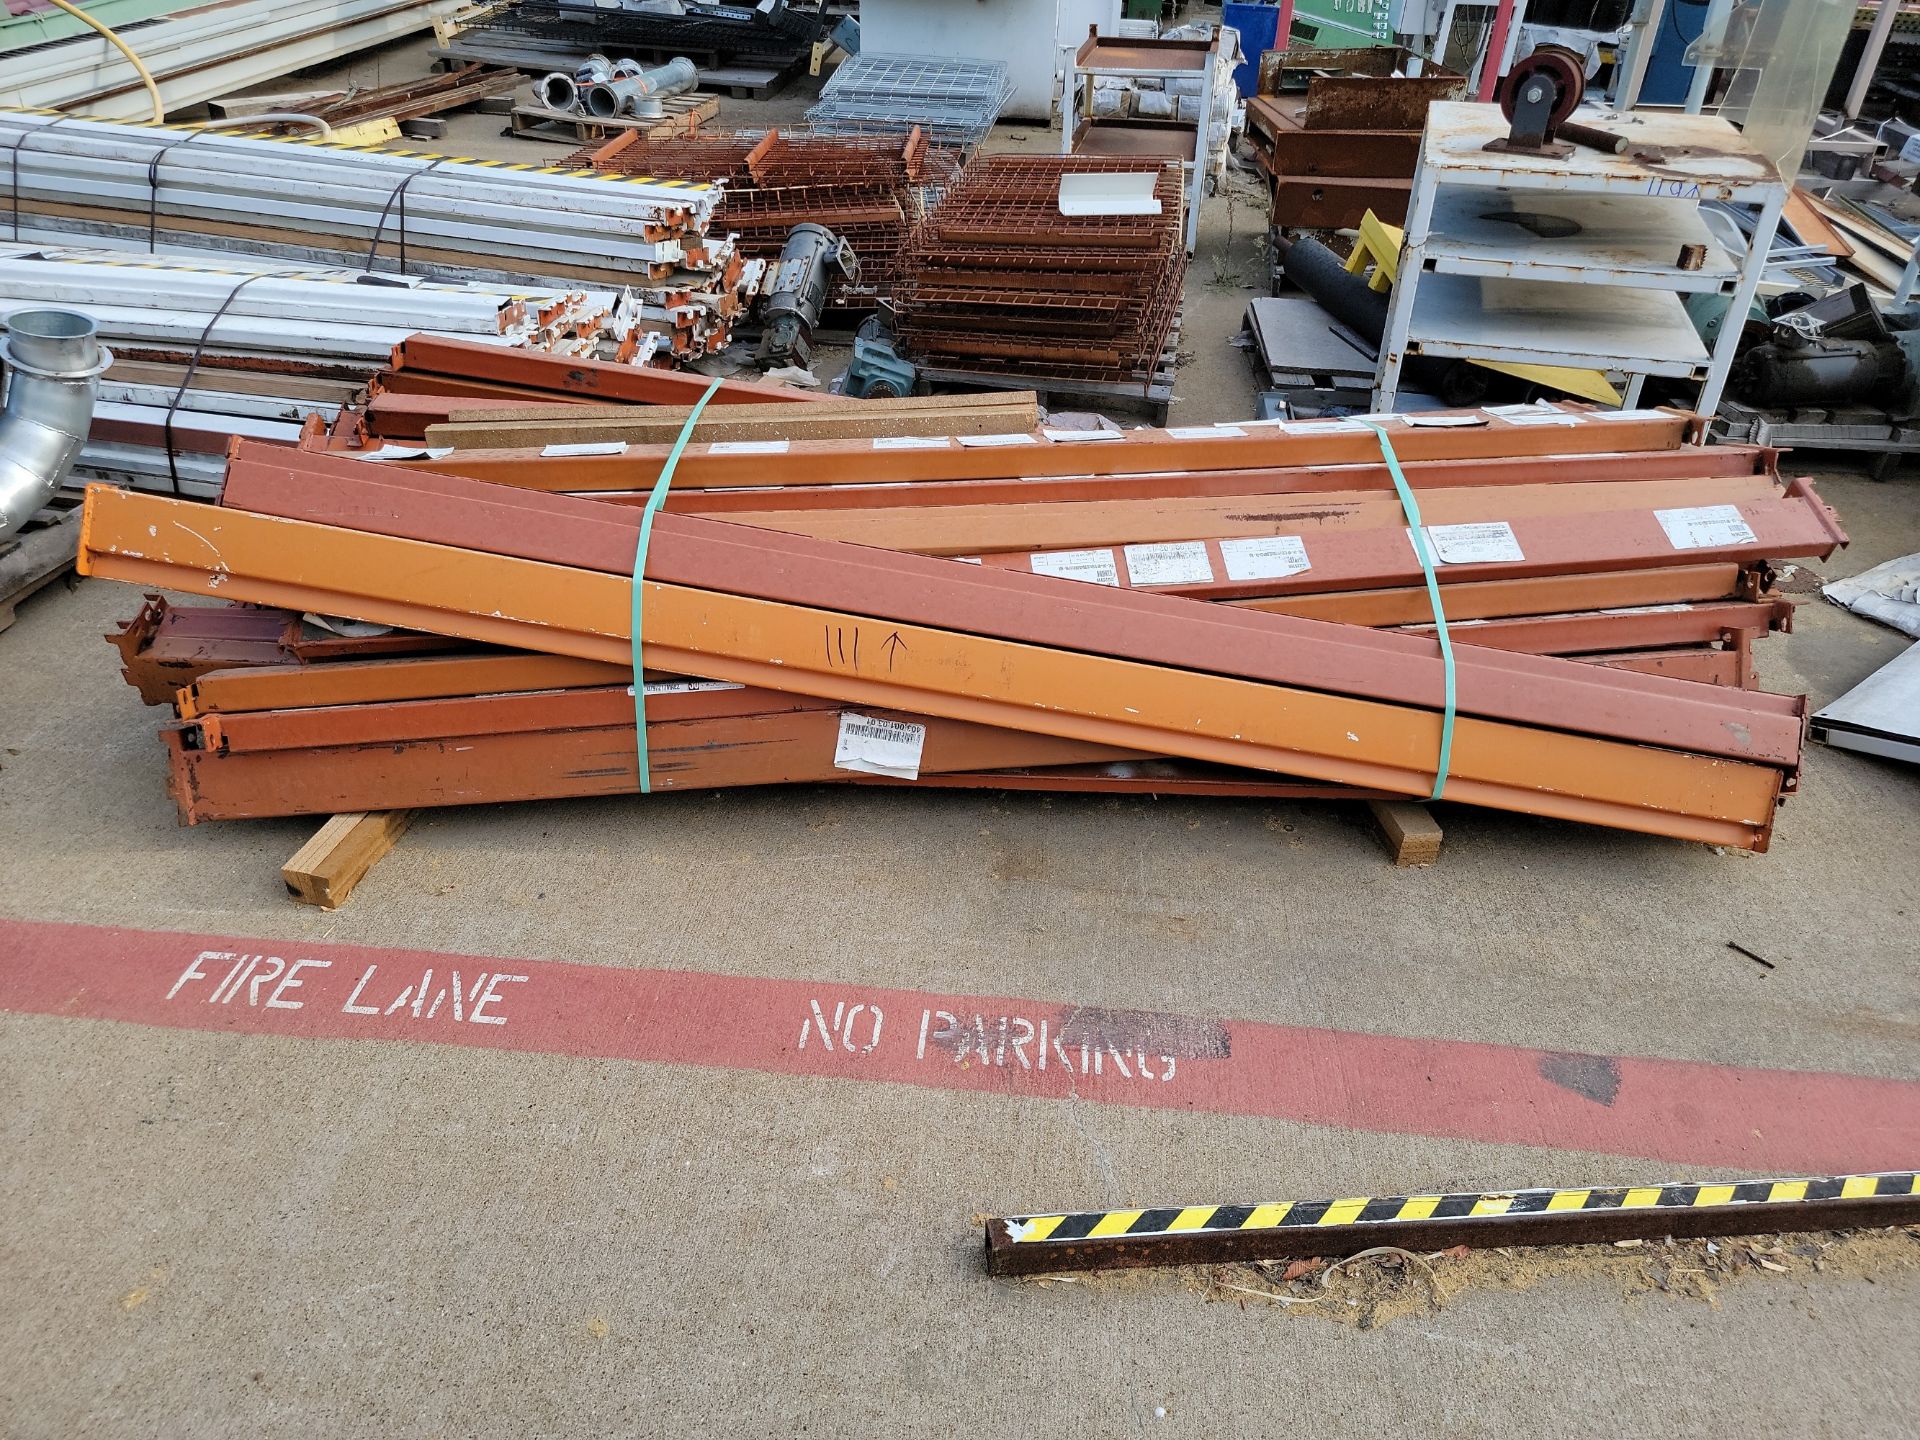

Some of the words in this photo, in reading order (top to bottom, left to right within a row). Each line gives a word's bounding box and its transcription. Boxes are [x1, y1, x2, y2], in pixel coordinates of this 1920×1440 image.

[166, 951, 332, 1010] FIRE
[342, 964, 529, 1025] LANE
[799, 999, 883, 1054] NO
[916, 1009, 1177, 1082] PARKING
